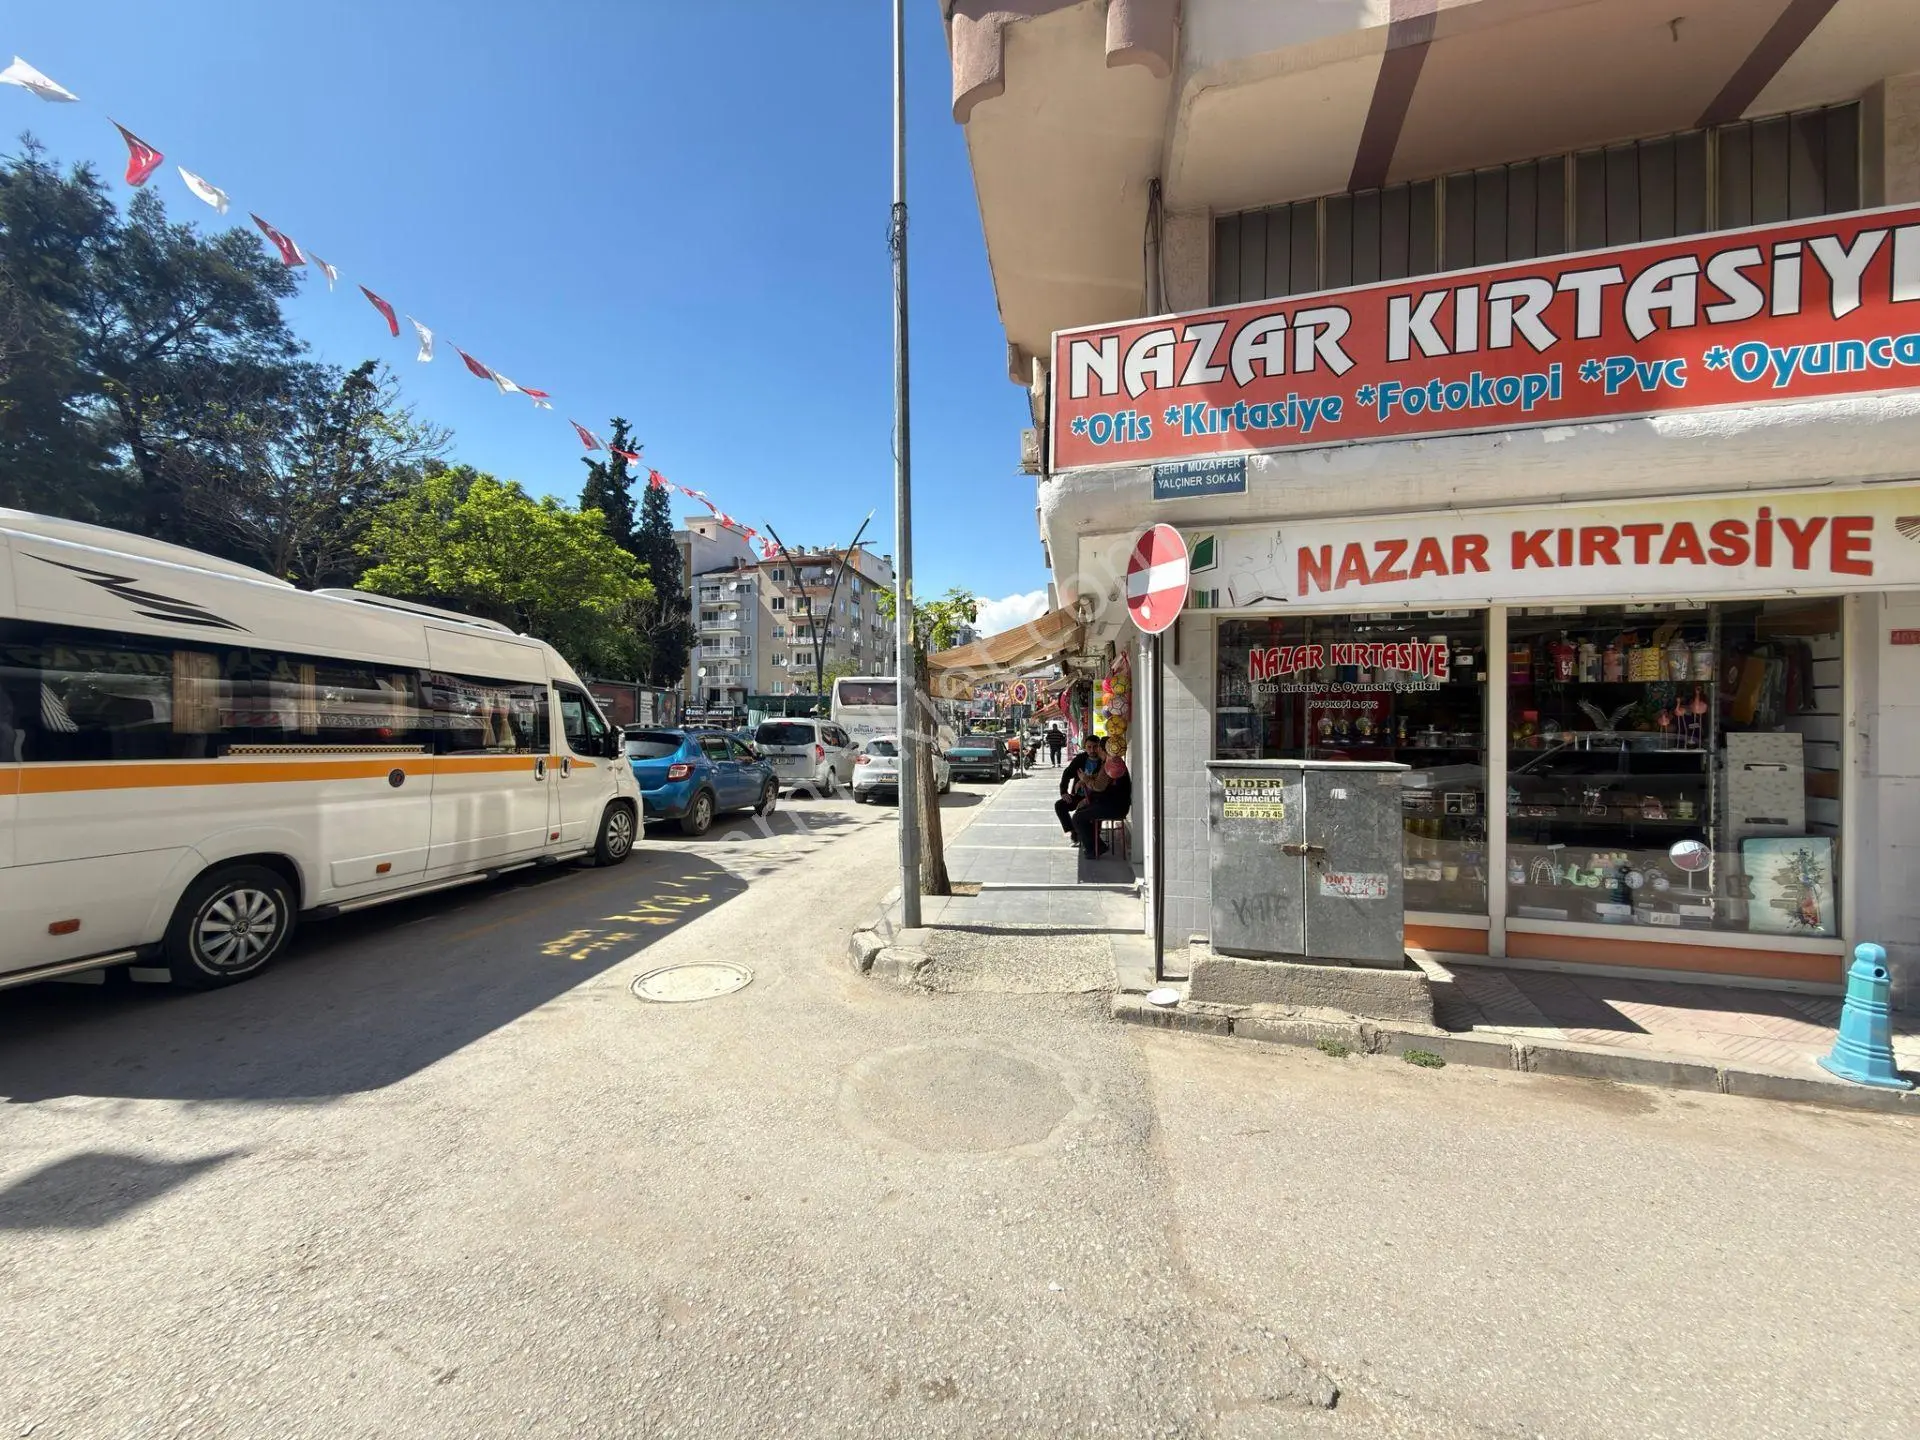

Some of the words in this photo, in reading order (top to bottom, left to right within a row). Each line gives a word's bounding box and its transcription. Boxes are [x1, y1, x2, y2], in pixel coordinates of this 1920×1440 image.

[1070, 305, 1356, 400] NAZAR
[1205, 473, 1241, 485] SOKAK
[1298, 534, 1490, 596] NAZAR
[1511, 507, 1873, 576] KIRTASİYE
[1249, 644, 1325, 682] NAZAR
[1330, 637, 1449, 679] KIRTASİYE
[1258, 682, 1278, 693] Ofis
[1344, 682, 1392, 695] Oyuncak
